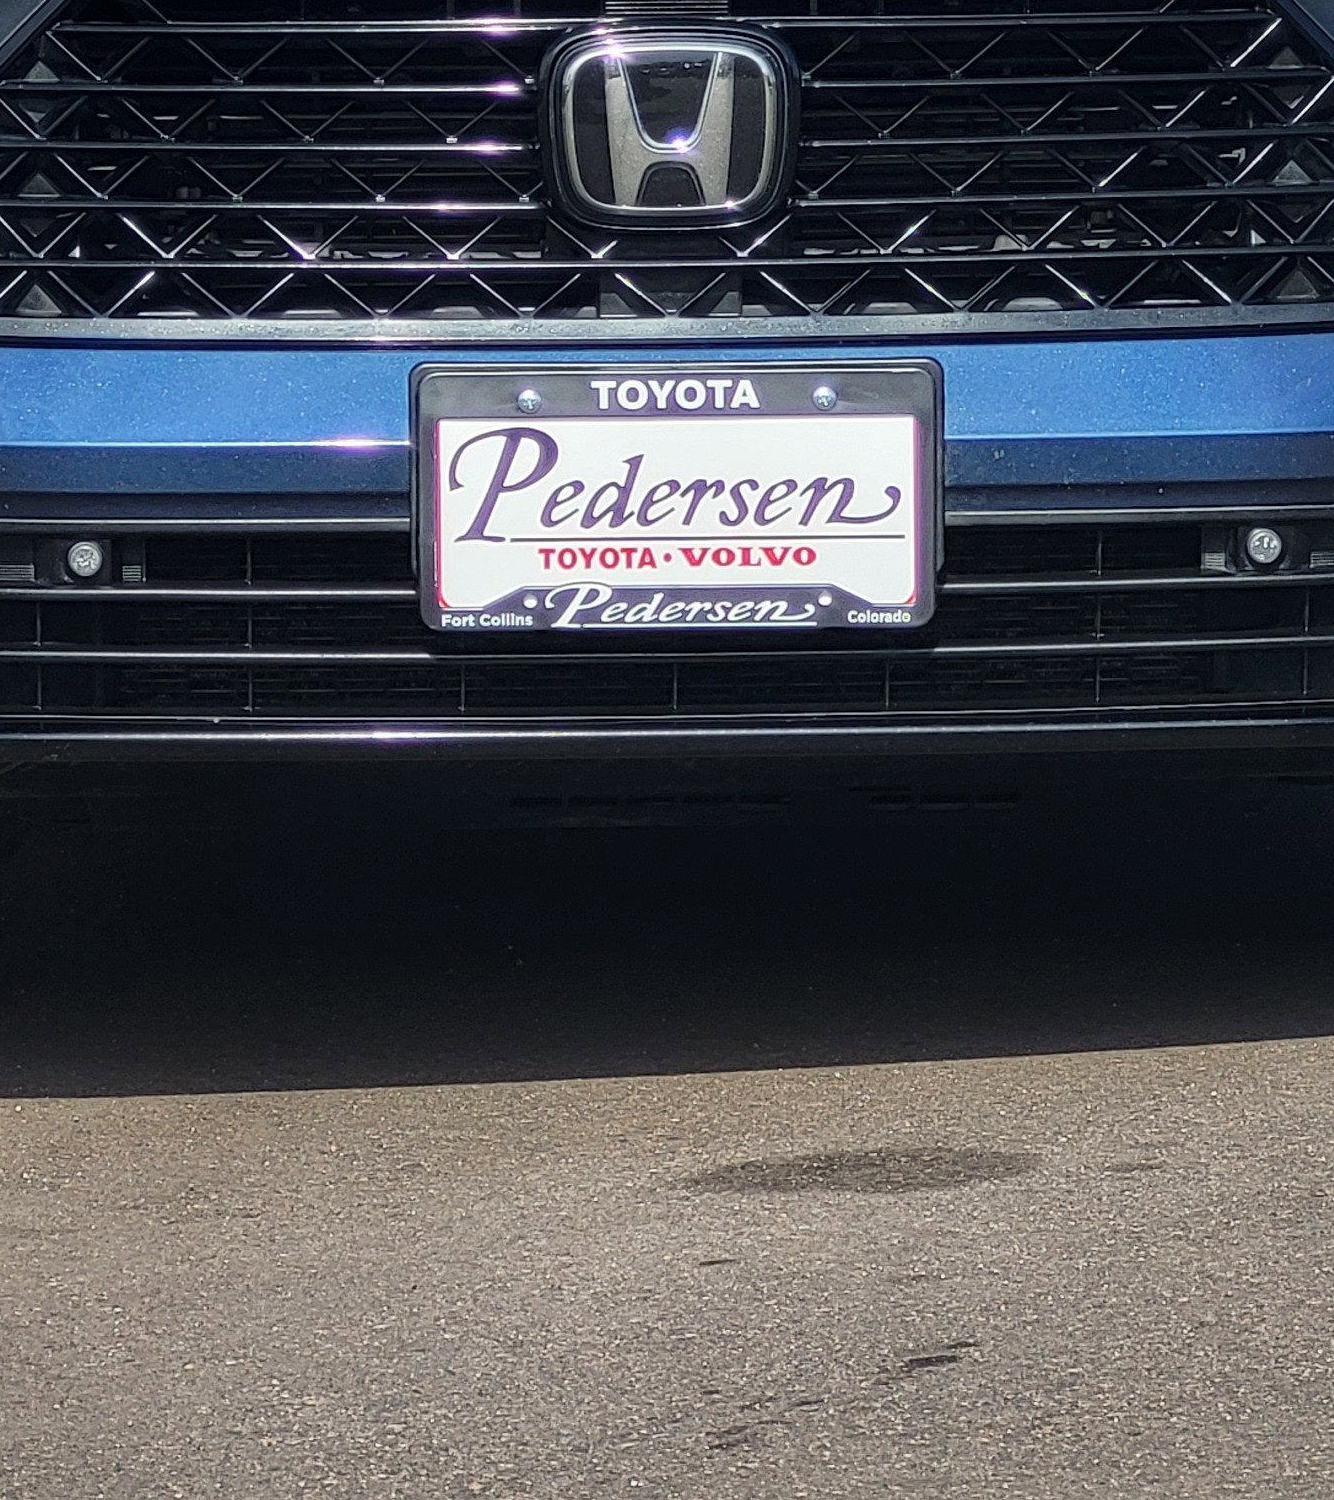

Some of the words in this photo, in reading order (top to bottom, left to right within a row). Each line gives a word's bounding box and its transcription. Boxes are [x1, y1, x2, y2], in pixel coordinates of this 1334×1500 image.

[590, 379, 761, 410] TOYOTA
[449, 426, 902, 543] Pedersen
[538, 547, 658, 570] TOYOTA
[678, 546, 817, 567] VOLVO
[544, 582, 816, 628] Pedersen
[847, 609, 911, 624] Colorado
[441, 613, 476, 627] Fort
[479, 612, 534, 627] Collins
